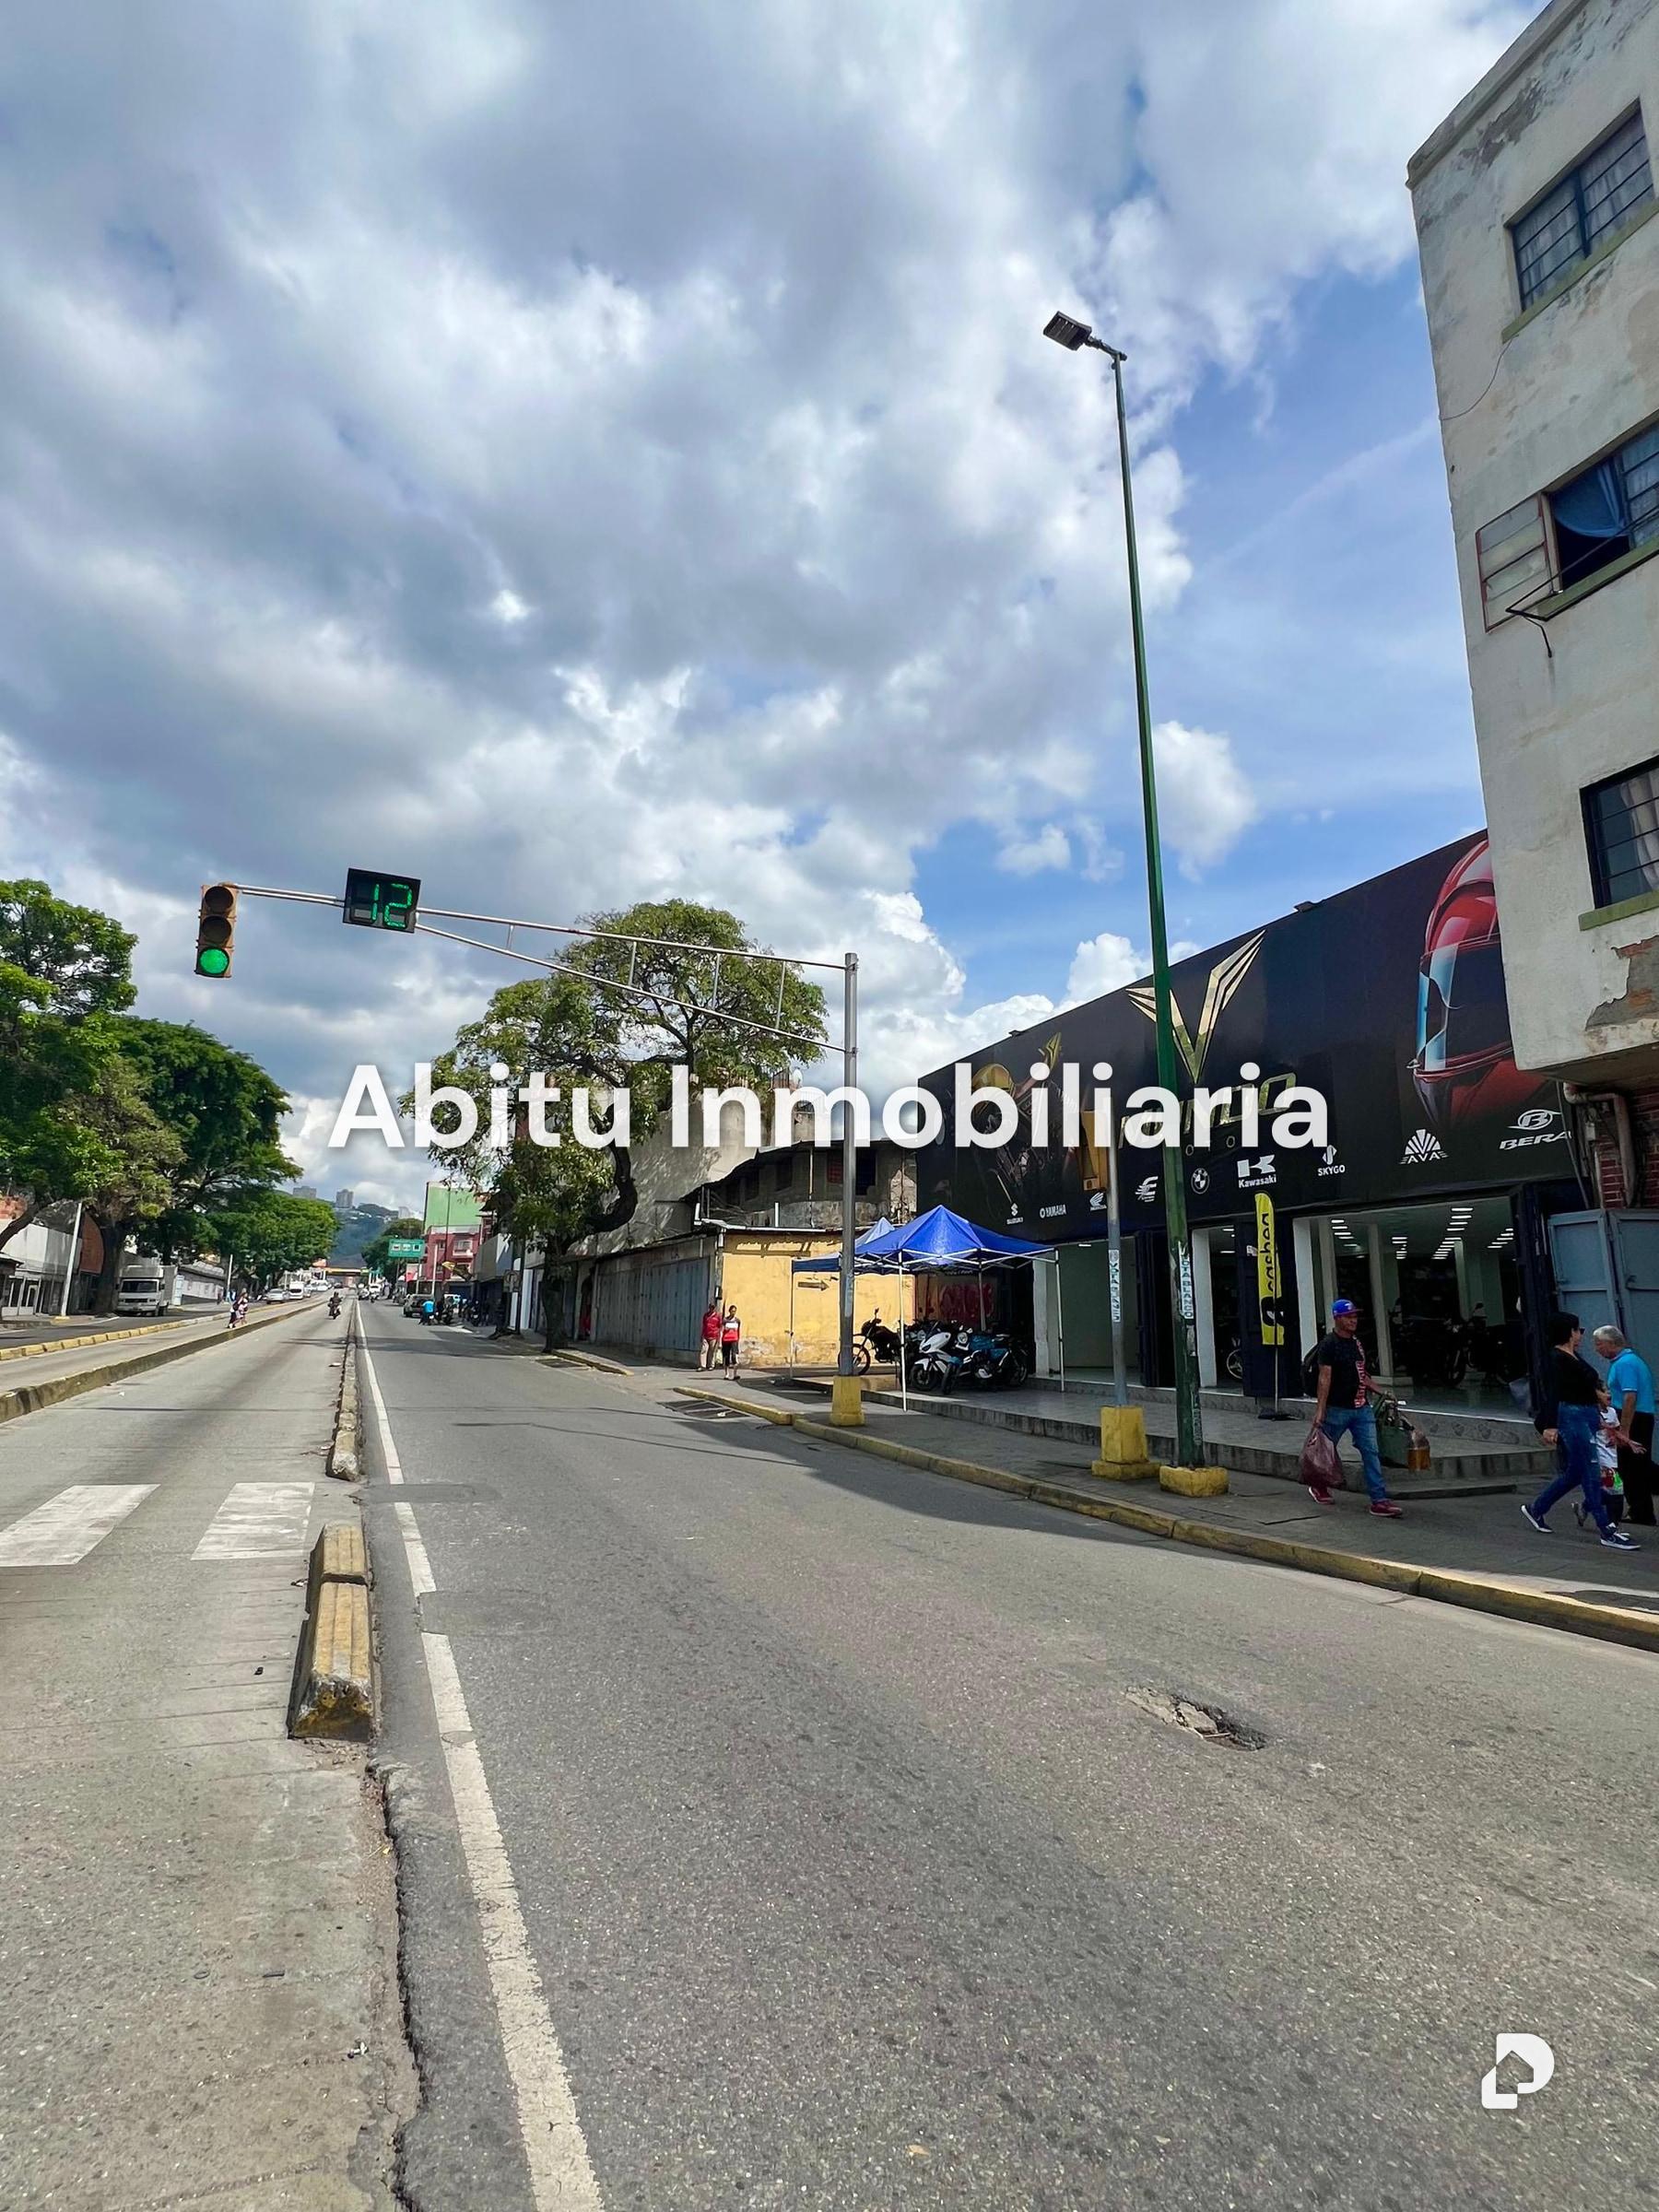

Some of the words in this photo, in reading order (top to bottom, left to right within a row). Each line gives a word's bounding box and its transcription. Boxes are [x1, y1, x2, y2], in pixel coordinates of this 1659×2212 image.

[371, 883, 412, 927] 12
[1499, 1130, 1572, 1150] BERA
[1407, 1151, 1441, 1164] AVA
[1317, 1164, 1346, 1176] SKYGO
[1238, 1174, 1277, 1189] Kawasaki
[1260, 1213, 1276, 1292] cashea
